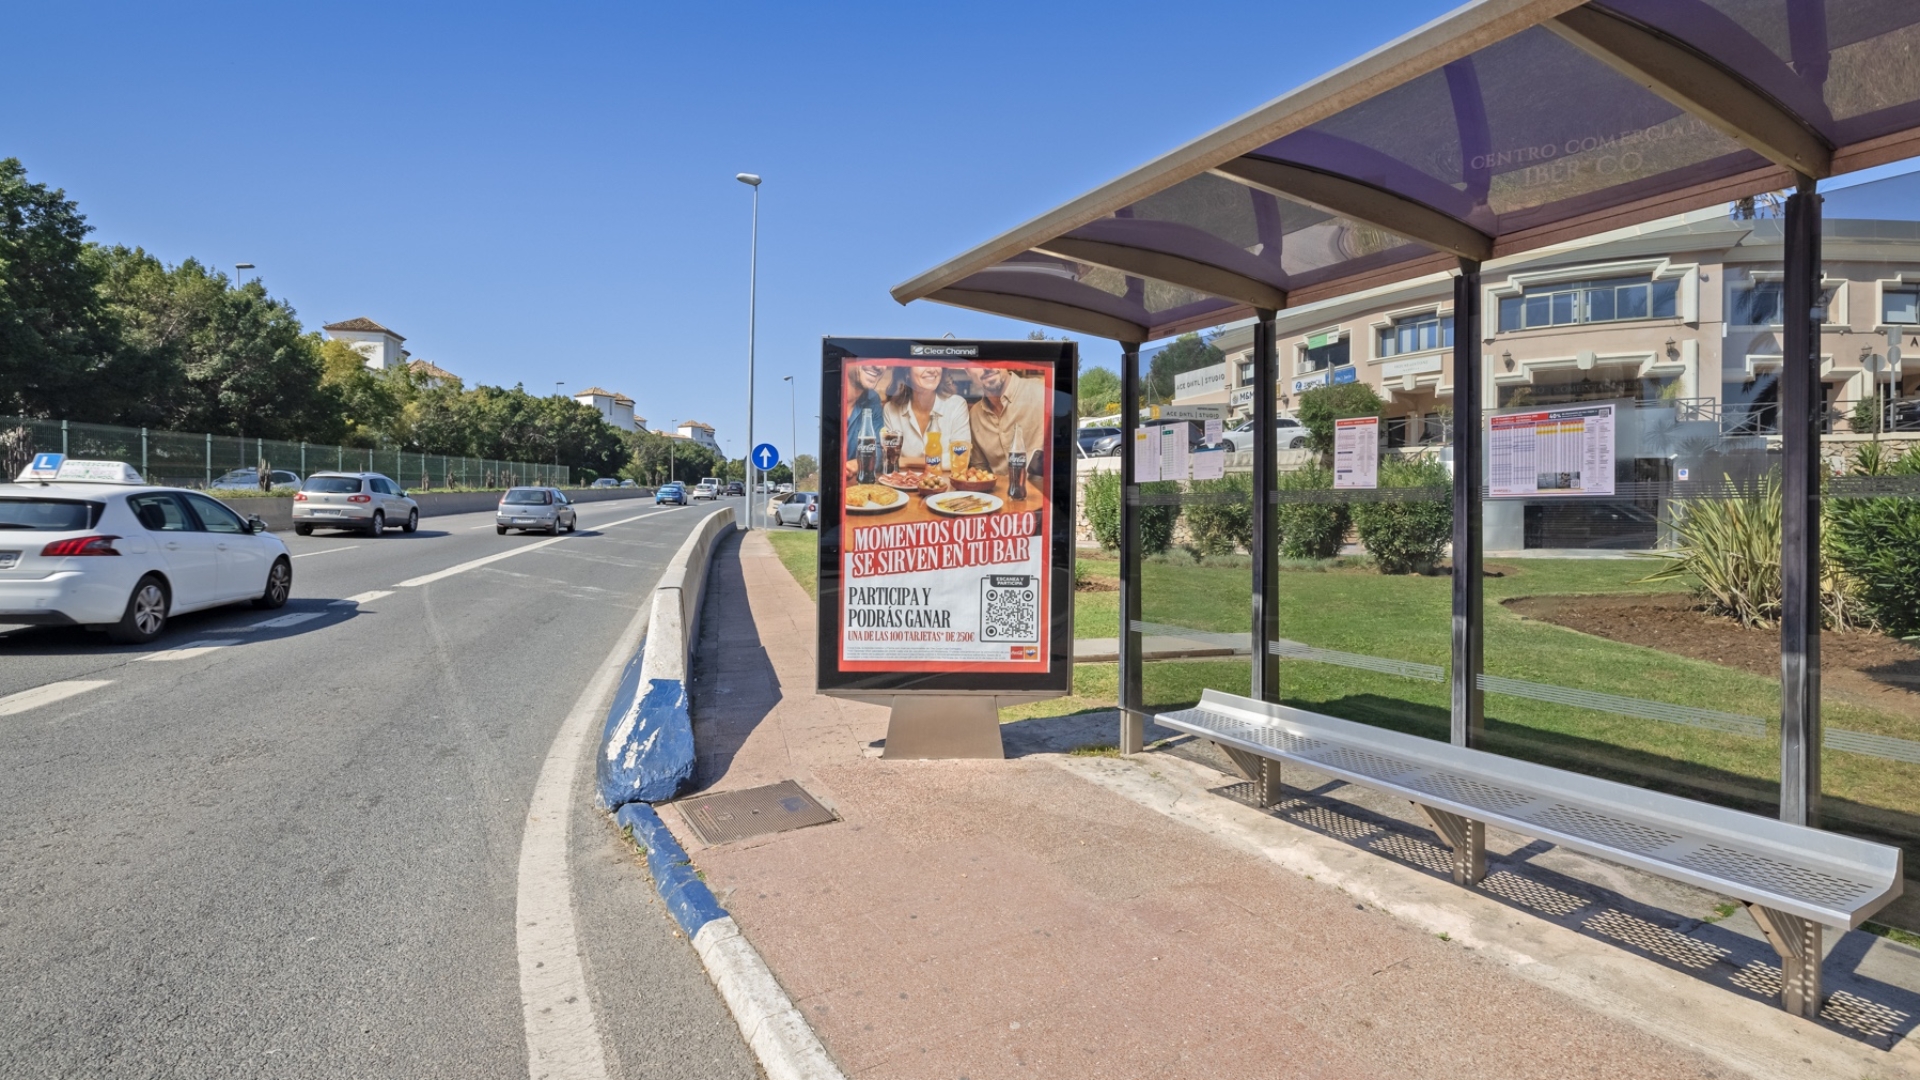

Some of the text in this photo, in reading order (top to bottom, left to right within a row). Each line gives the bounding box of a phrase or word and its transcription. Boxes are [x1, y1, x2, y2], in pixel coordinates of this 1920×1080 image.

[1470, 143, 1557, 170] CENTRO
[924, 347, 976, 356] Clear Channel
[1176, 382, 1186, 390] ACE
[1204, 373, 1225, 384] STUDIO
[38, 456, 53, 468] L
[854, 512, 1035, 551] MOMENTOS QUE SOLO
[853, 537, 1029, 577] SE SIRVEN EN TU BAR
[848, 586, 932, 606] PARTICIPA Y
[848, 605, 951, 628] PODRÁS GANAR
[848, 630, 863, 641] UNA
[864, 630, 875, 641] DE
[875, 630, 889, 641] LAS
[889, 631, 904, 642] 100
[945, 632, 956, 642] DE
[956, 632, 975, 643] 250€
